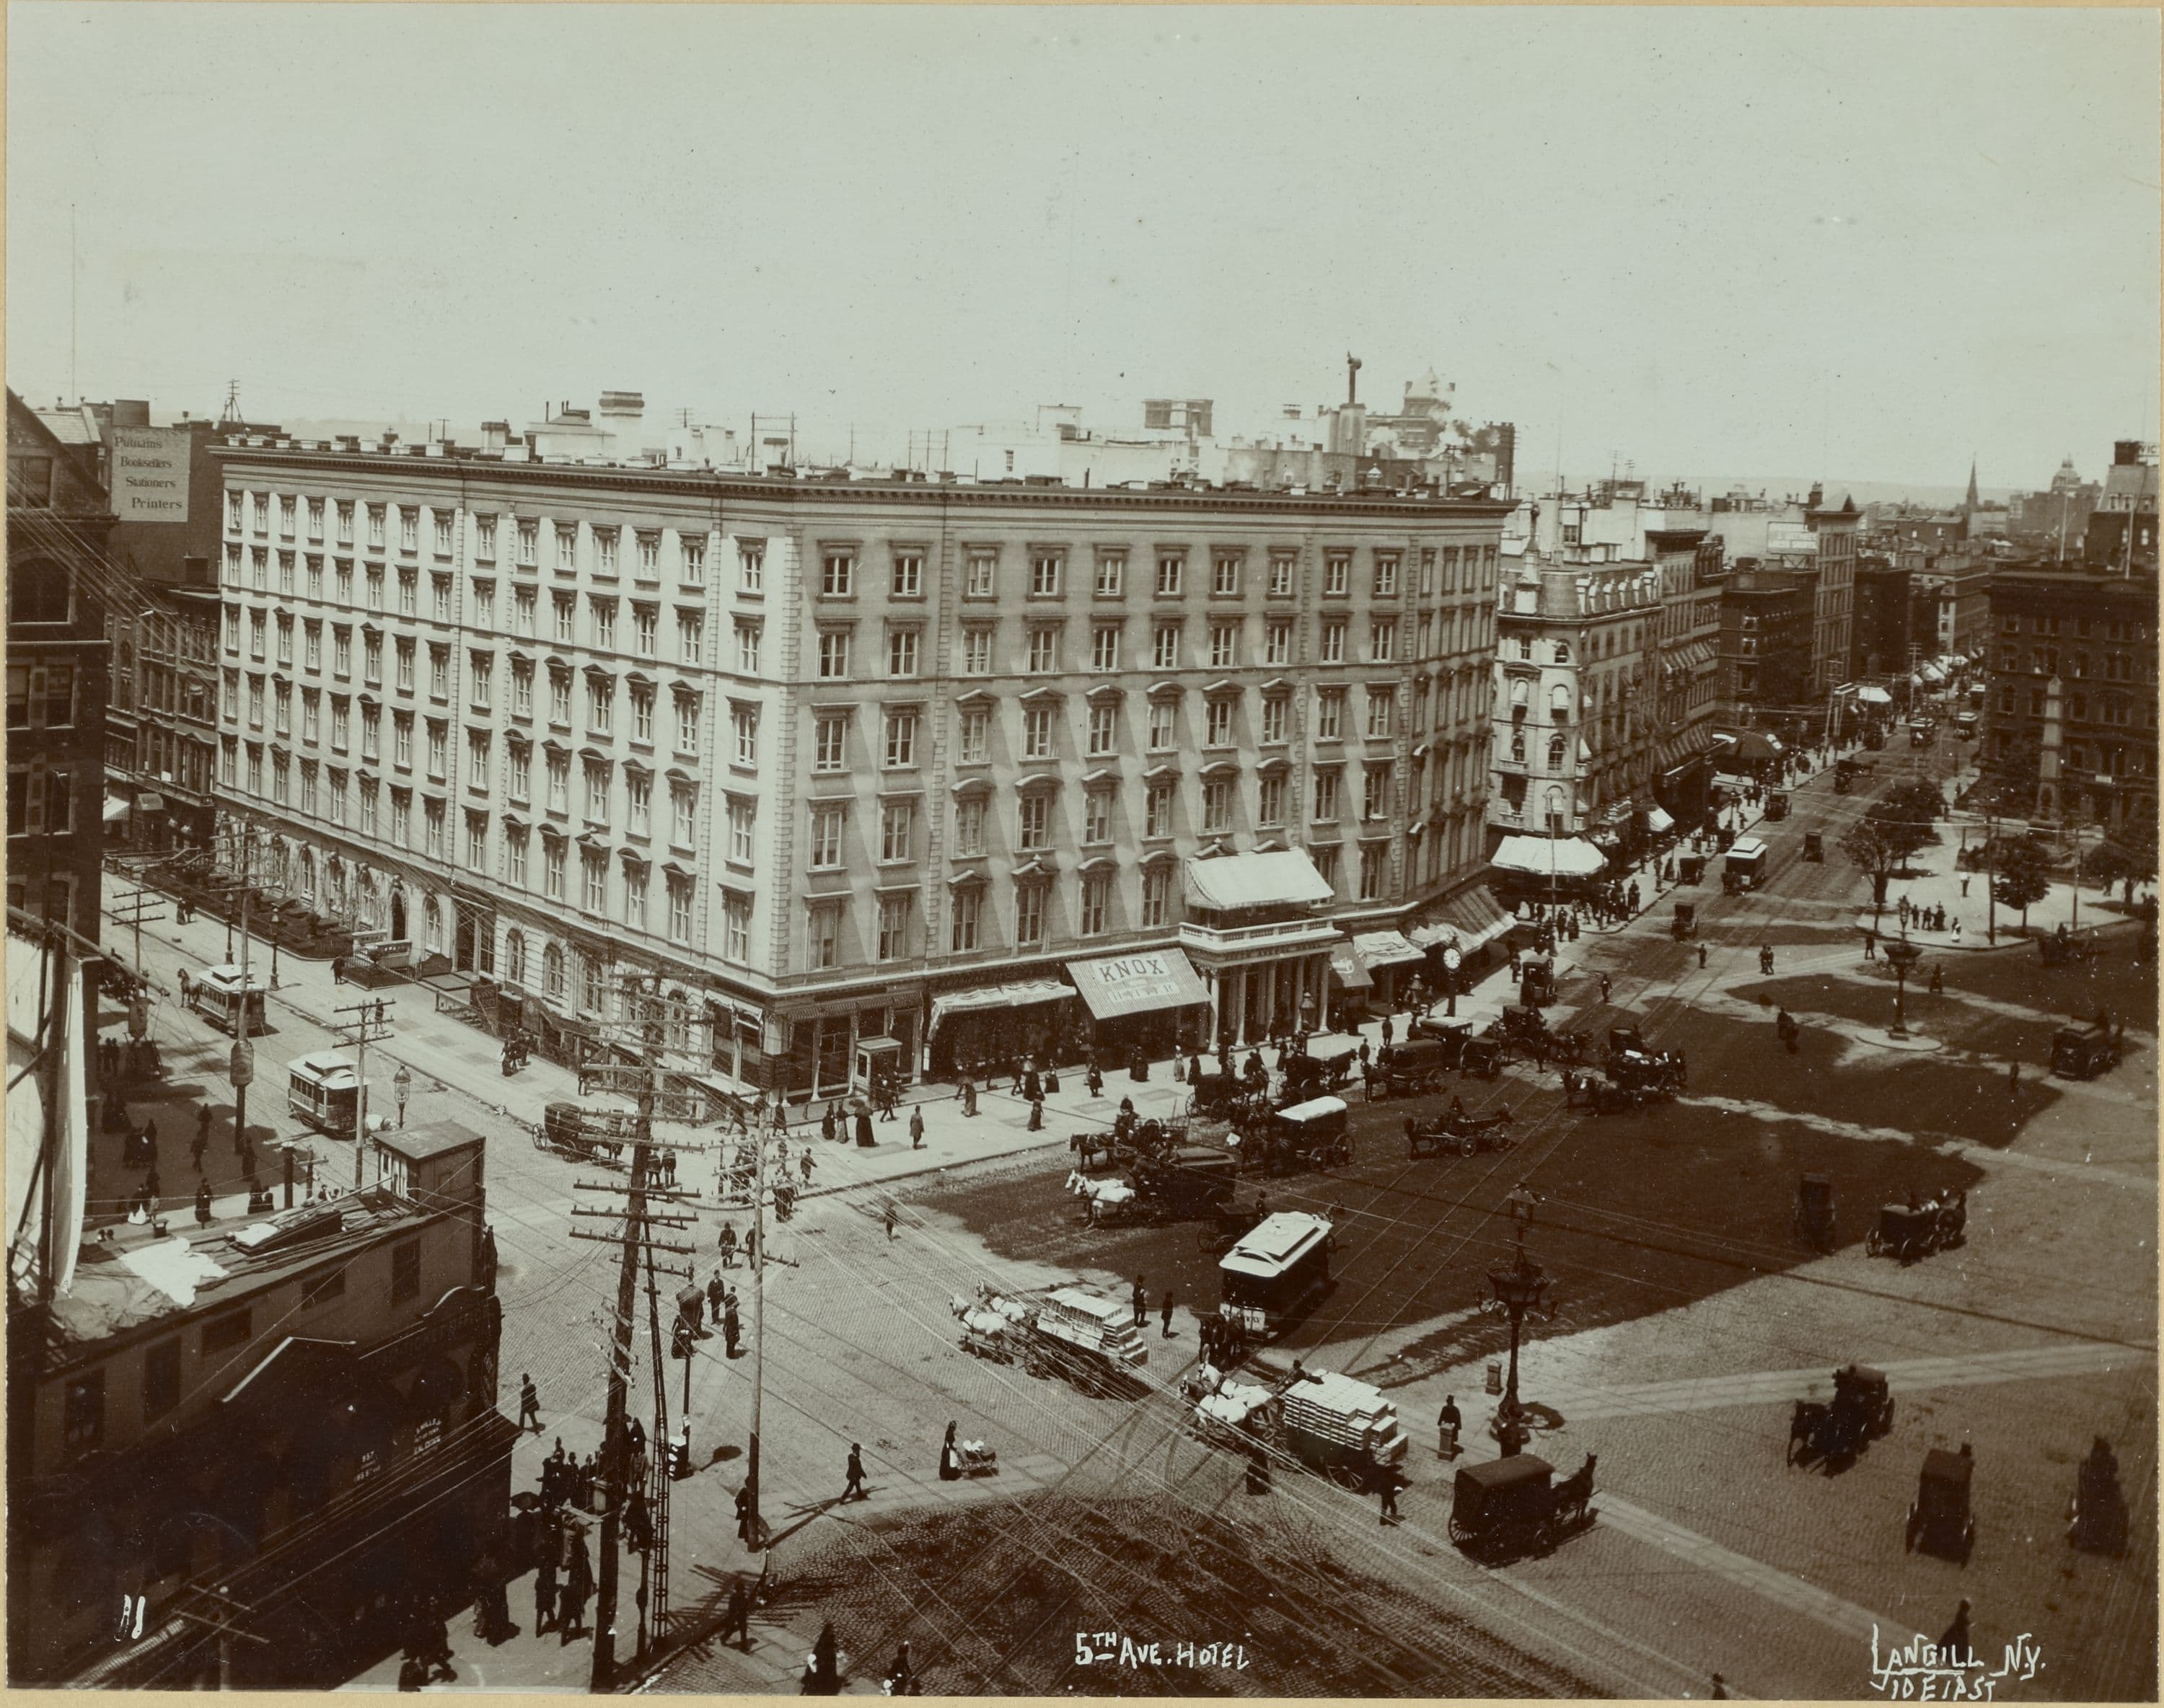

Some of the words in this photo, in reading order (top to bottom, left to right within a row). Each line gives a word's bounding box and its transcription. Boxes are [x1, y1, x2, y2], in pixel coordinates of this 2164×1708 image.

[120, 456, 172, 468] Booksellers
[126, 476, 177, 488] Stationers
[131, 497, 183, 509] Printers
[1099, 959, 1165, 983] KNOX
